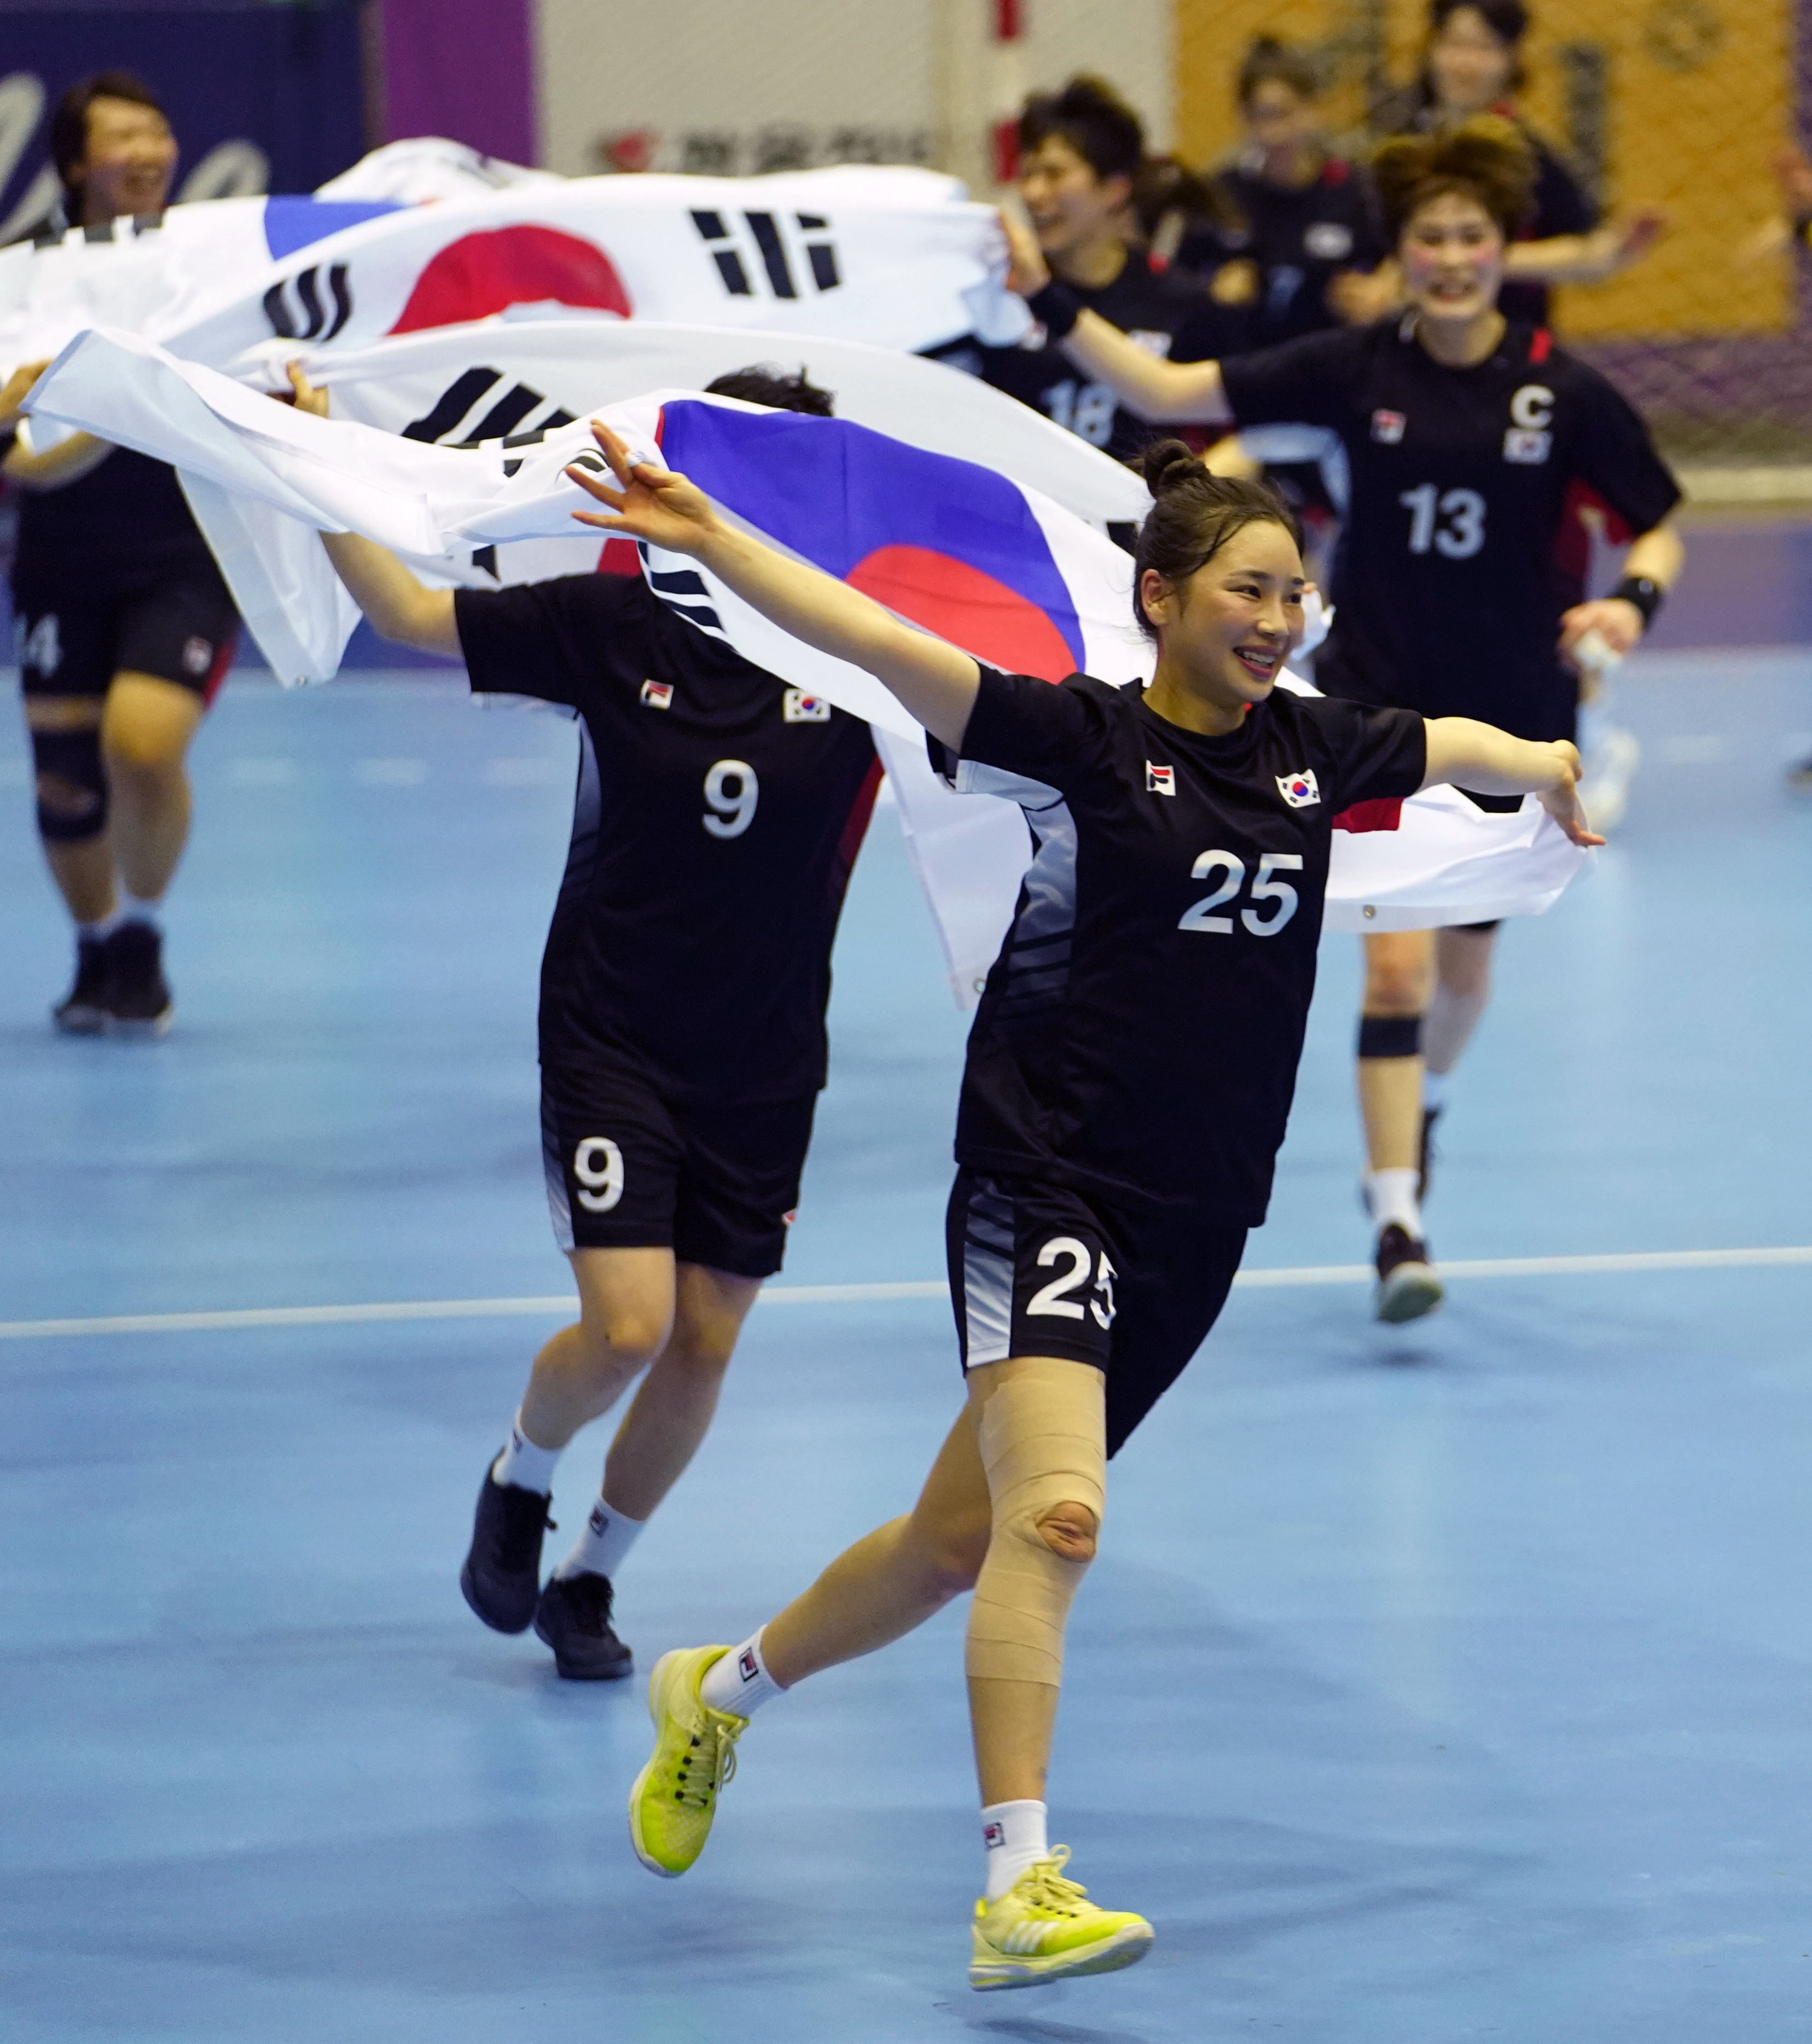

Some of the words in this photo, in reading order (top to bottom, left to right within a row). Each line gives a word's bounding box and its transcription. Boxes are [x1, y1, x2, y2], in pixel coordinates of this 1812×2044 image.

[1041, 380, 1114, 446] 18
[1511, 385, 1554, 429] C
[1399, 483, 1486, 559] 13
[702, 759, 759, 837] 9
[1178, 849, 1303, 936] 25
[574, 1137, 624, 1211] 9
[1026, 1237, 1118, 1330] 25
